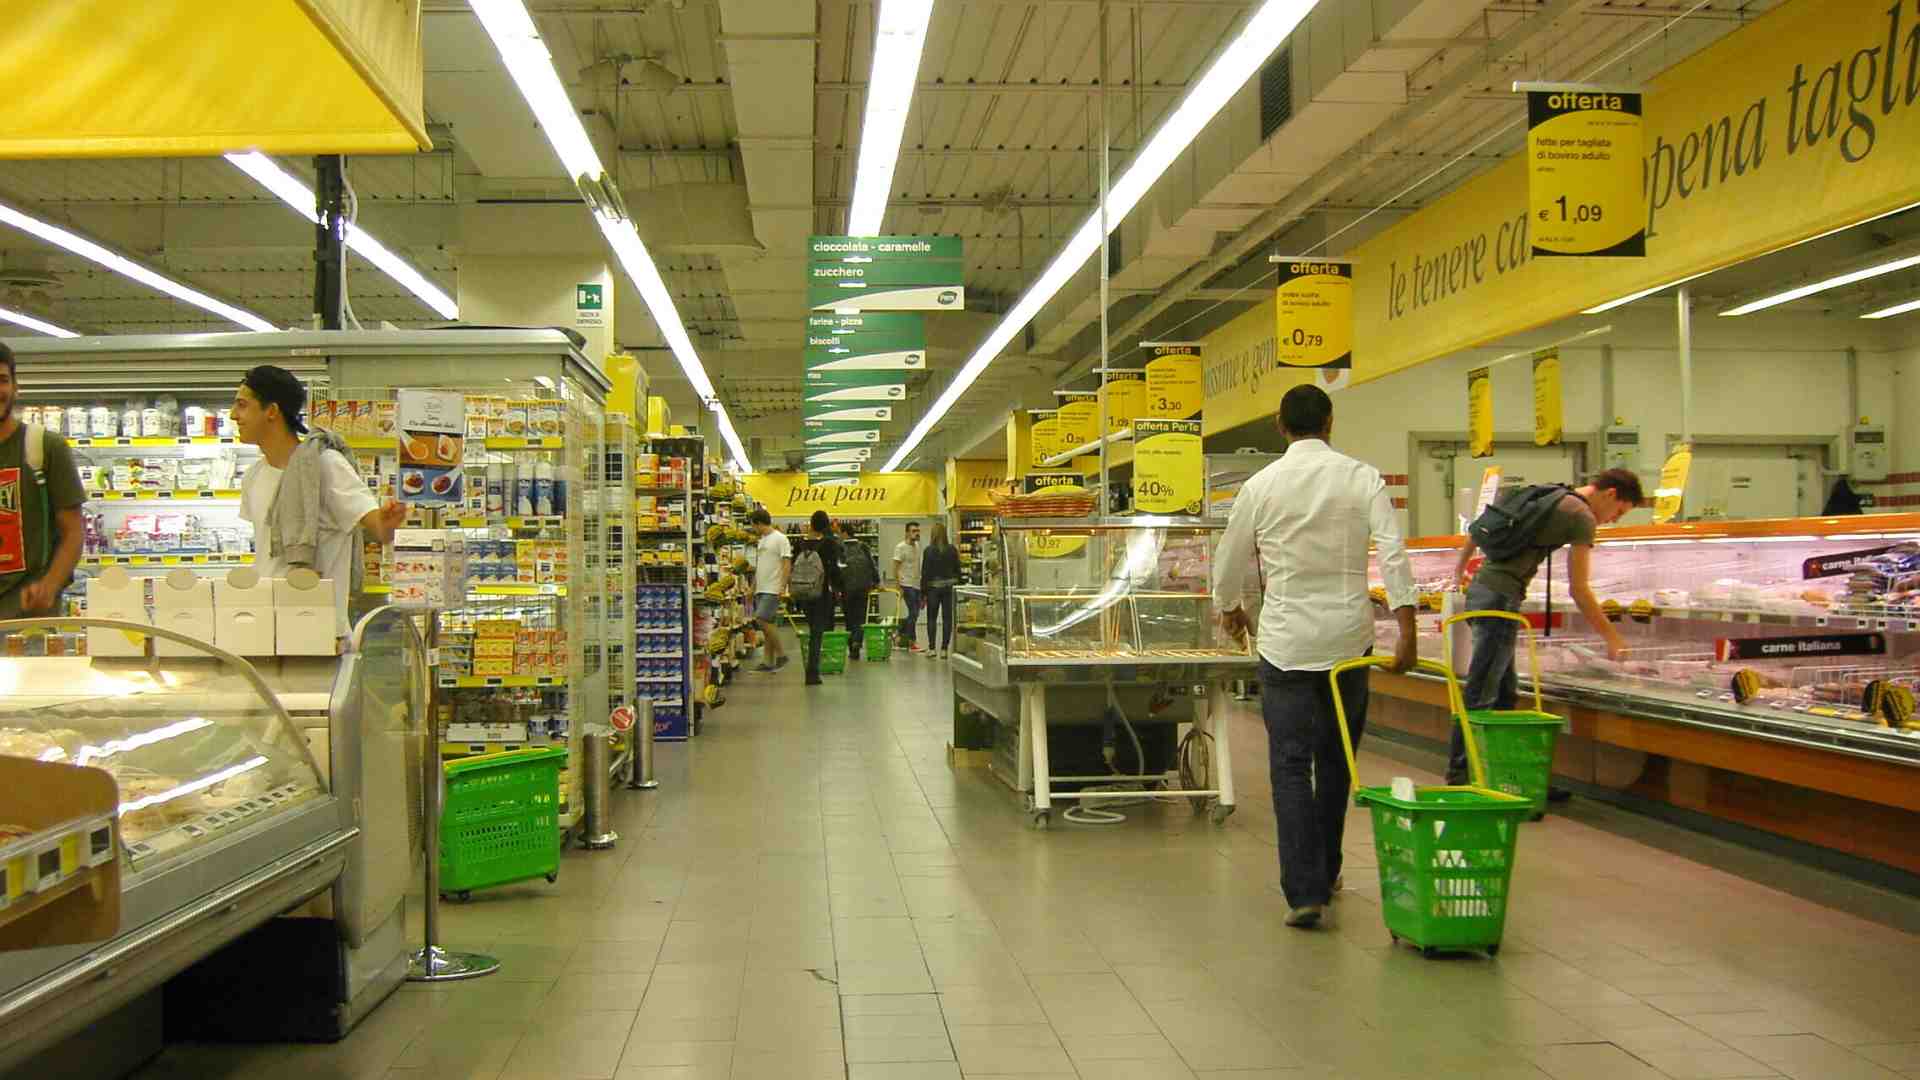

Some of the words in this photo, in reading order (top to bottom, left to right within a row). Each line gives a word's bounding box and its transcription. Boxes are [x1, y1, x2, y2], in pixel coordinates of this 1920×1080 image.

[1547, 92, 1623, 110] offerta
[1559, 139, 1575, 148] per
[1536, 152, 1546, 160] di
[1388, 261, 1406, 320] le
[1412, 233, 1487, 310] tenere
[1496, 212, 1534, 274] ca
[1642, 96, 1768, 238] pena
[813, 241, 868, 252] cioccolata
[878, 241, 931, 252] caramelle
[813, 267, 864, 277] zucchero
[1290, 262, 1339, 275] offerta
[809, 336, 841, 345] biscotti
[1154, 345, 1192, 356] offerta
[1136, 422, 1169, 431] offerta
[1035, 477, 1074, 486] offerta
[1138, 481, 1175, 497] 40%
[833, 485, 889, 506] pam
[1761, 641, 1796, 654] carne
[1797, 639, 1841, 652] italiana
